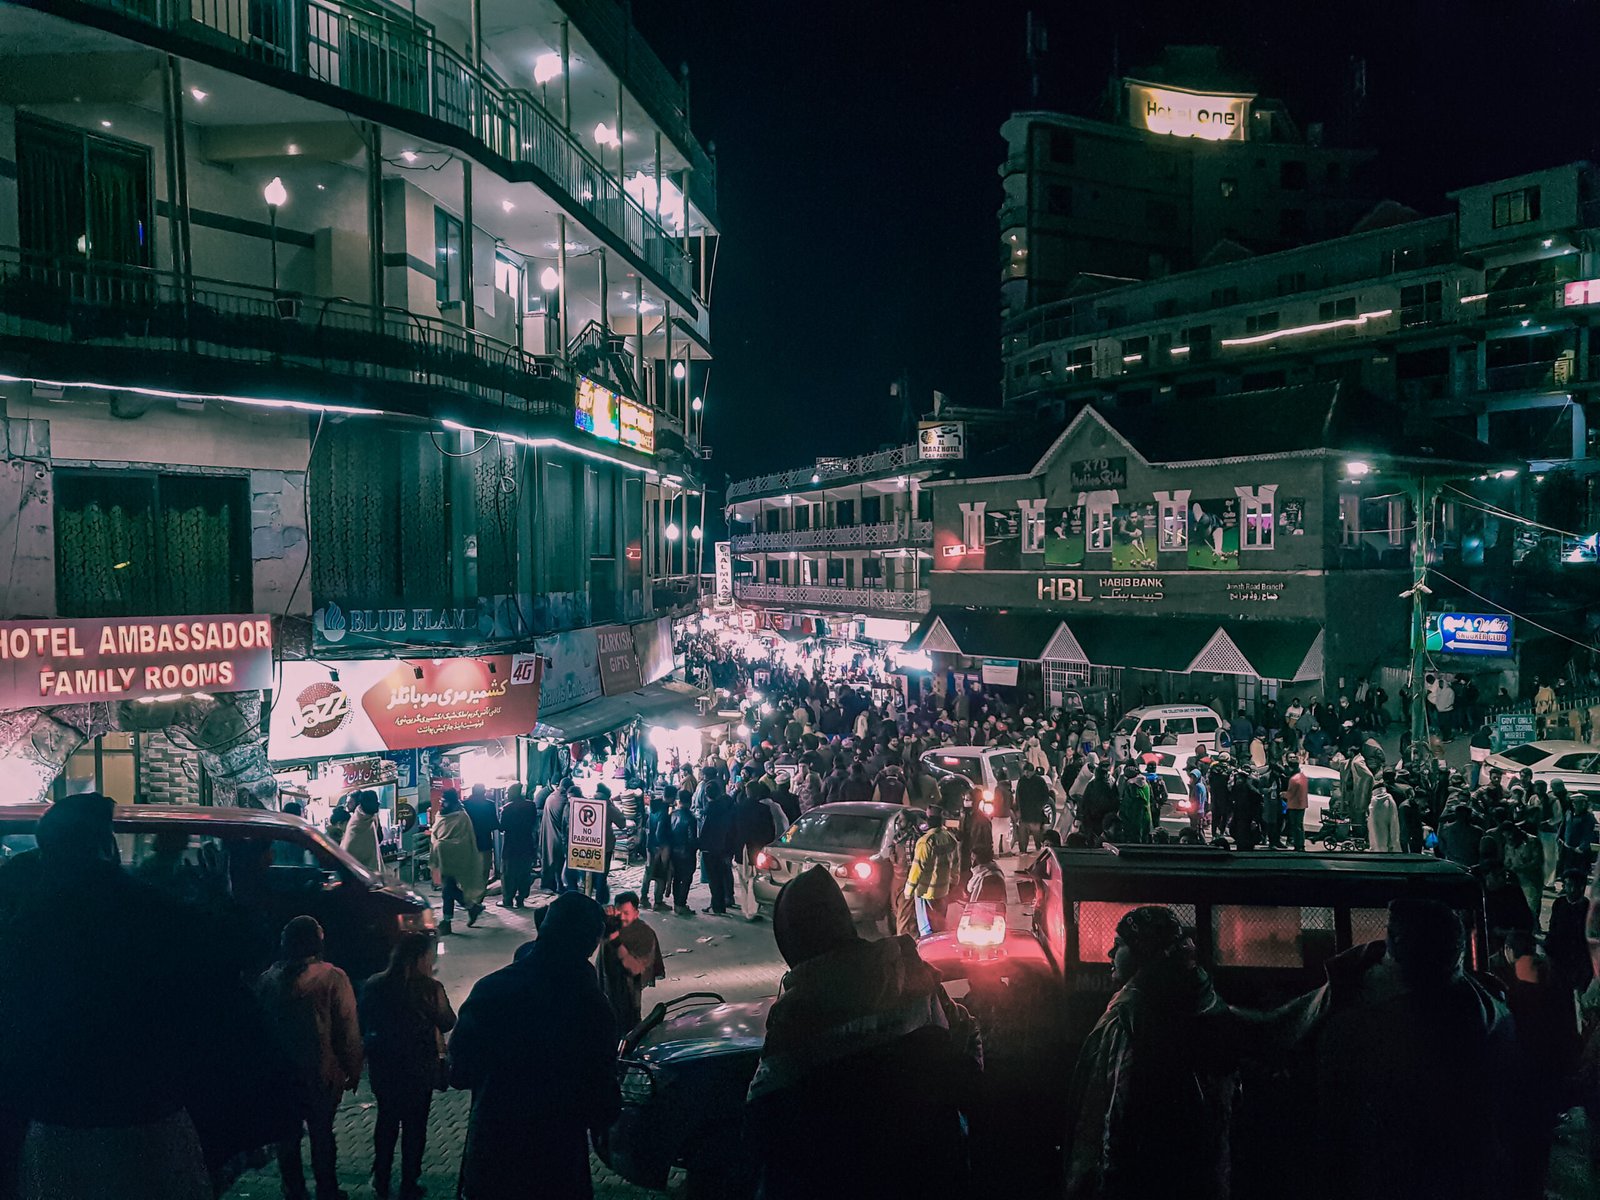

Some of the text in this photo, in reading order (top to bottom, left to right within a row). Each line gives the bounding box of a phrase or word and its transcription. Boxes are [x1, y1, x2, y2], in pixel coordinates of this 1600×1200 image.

[1147, 101, 1235, 125] Hotl One
[1037, 578, 1093, 602] HBL
[1099, 578, 1163, 588] HABIB BANK
[349, 609, 406, 632] BLUE
[0, 620, 270, 659] HOTEL AMBASSADOR
[597, 632, 633, 654] ZARKISH
[1488, 633, 1506, 642] CLUB
[513, 664, 533, 681] 4G
[609, 654, 630, 673] GIFTS
[39, 661, 233, 697] FAMILY ROOMS
[573, 835, 601, 844] PARKING
